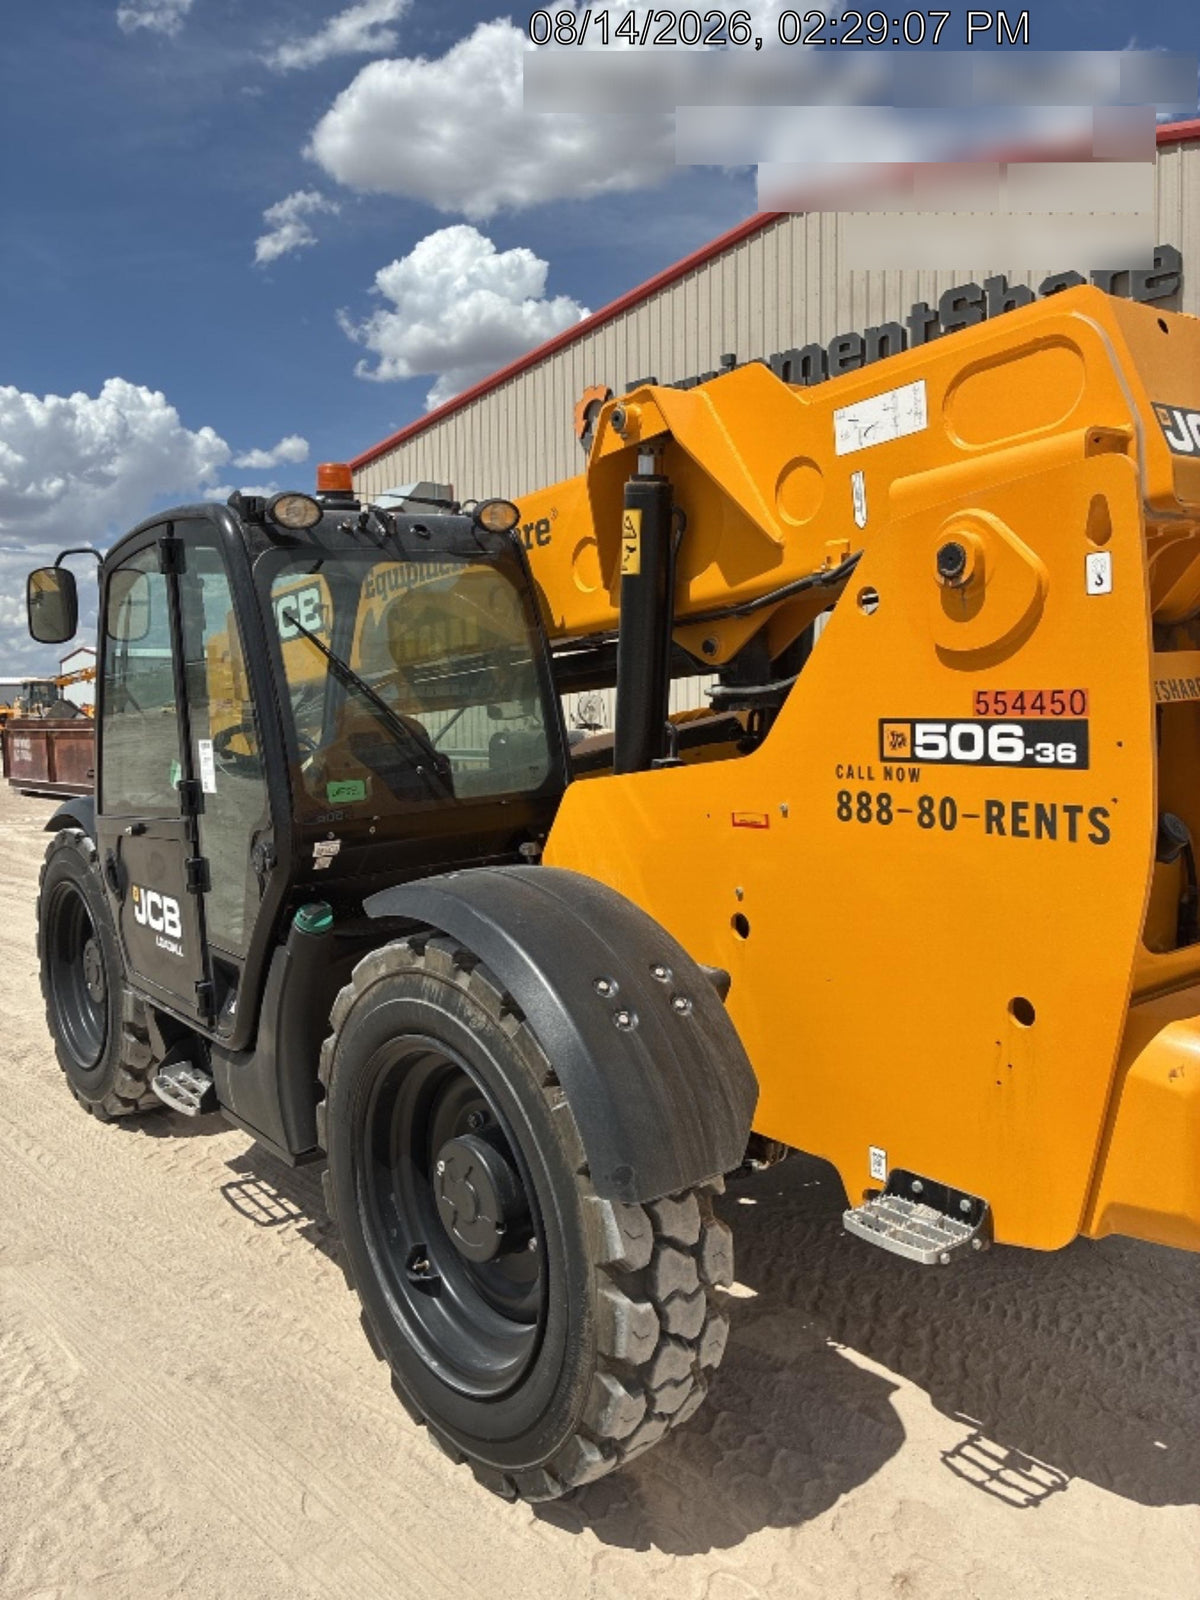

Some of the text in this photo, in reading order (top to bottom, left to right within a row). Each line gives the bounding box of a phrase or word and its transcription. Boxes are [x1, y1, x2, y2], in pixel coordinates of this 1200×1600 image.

[975, 689, 1087, 716] 554450
[914, 723, 1077, 763] 506-36
[835, 764, 921, 783] CALL NOW
[836, 790, 1111, 845] 888-80-RENTS
[134, 888, 182, 939] JCB
